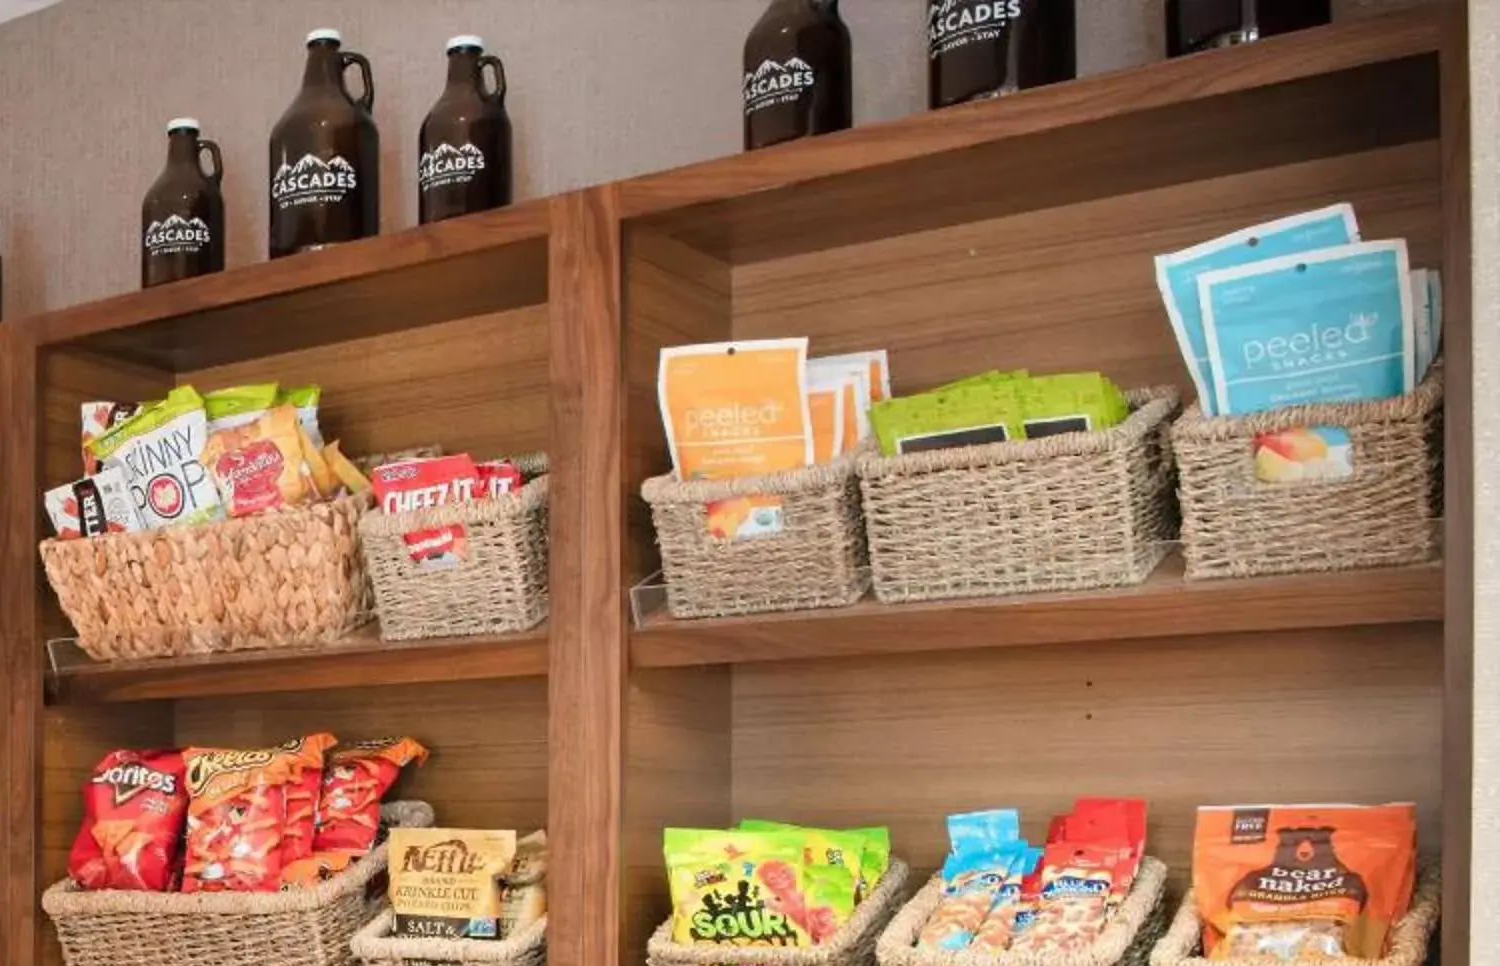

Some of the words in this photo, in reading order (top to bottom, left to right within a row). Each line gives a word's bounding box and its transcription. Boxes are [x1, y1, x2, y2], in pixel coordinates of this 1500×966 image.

[272, 172, 357, 199] CASCADES
[145, 229, 210, 248] CASCADES
[1243, 314, 1364, 369] peeled
[1271, 866, 1336, 881] bear
[1258, 876, 1345, 893] naked
[407, 919, 444, 933] SALT
[692, 910, 787, 938] SOUR
